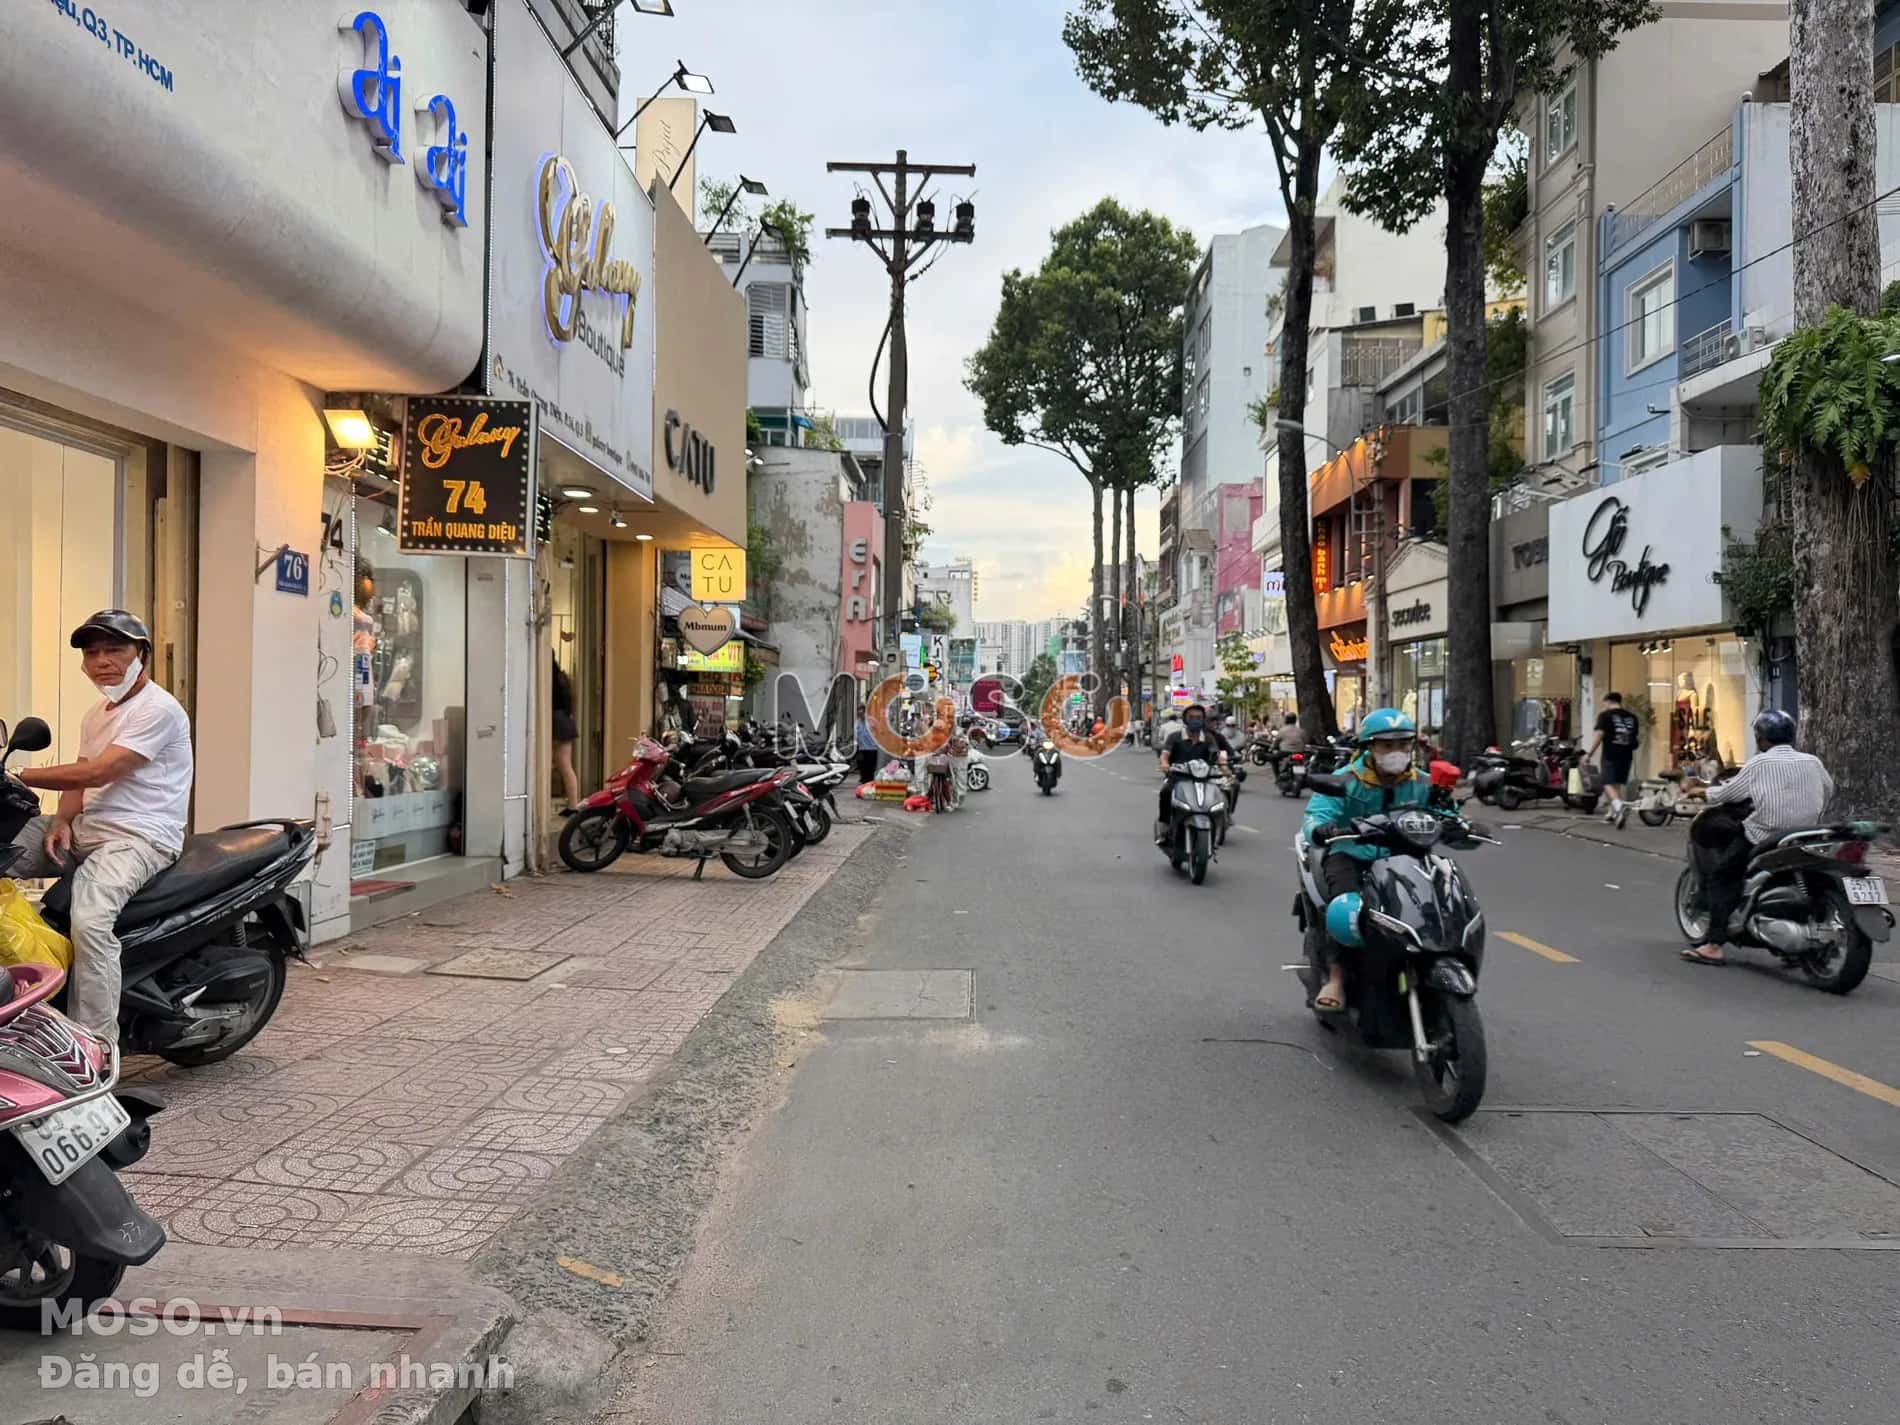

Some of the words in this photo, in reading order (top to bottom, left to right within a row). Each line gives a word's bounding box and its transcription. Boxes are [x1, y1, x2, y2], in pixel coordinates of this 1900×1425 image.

[112, 28, 174, 93] TP.HCM
[577, 308, 625, 379] Boutique
[442, 479, 487, 514] 74
[445, 522, 486, 540] QUANG
[284, 553, 303, 581] 76
